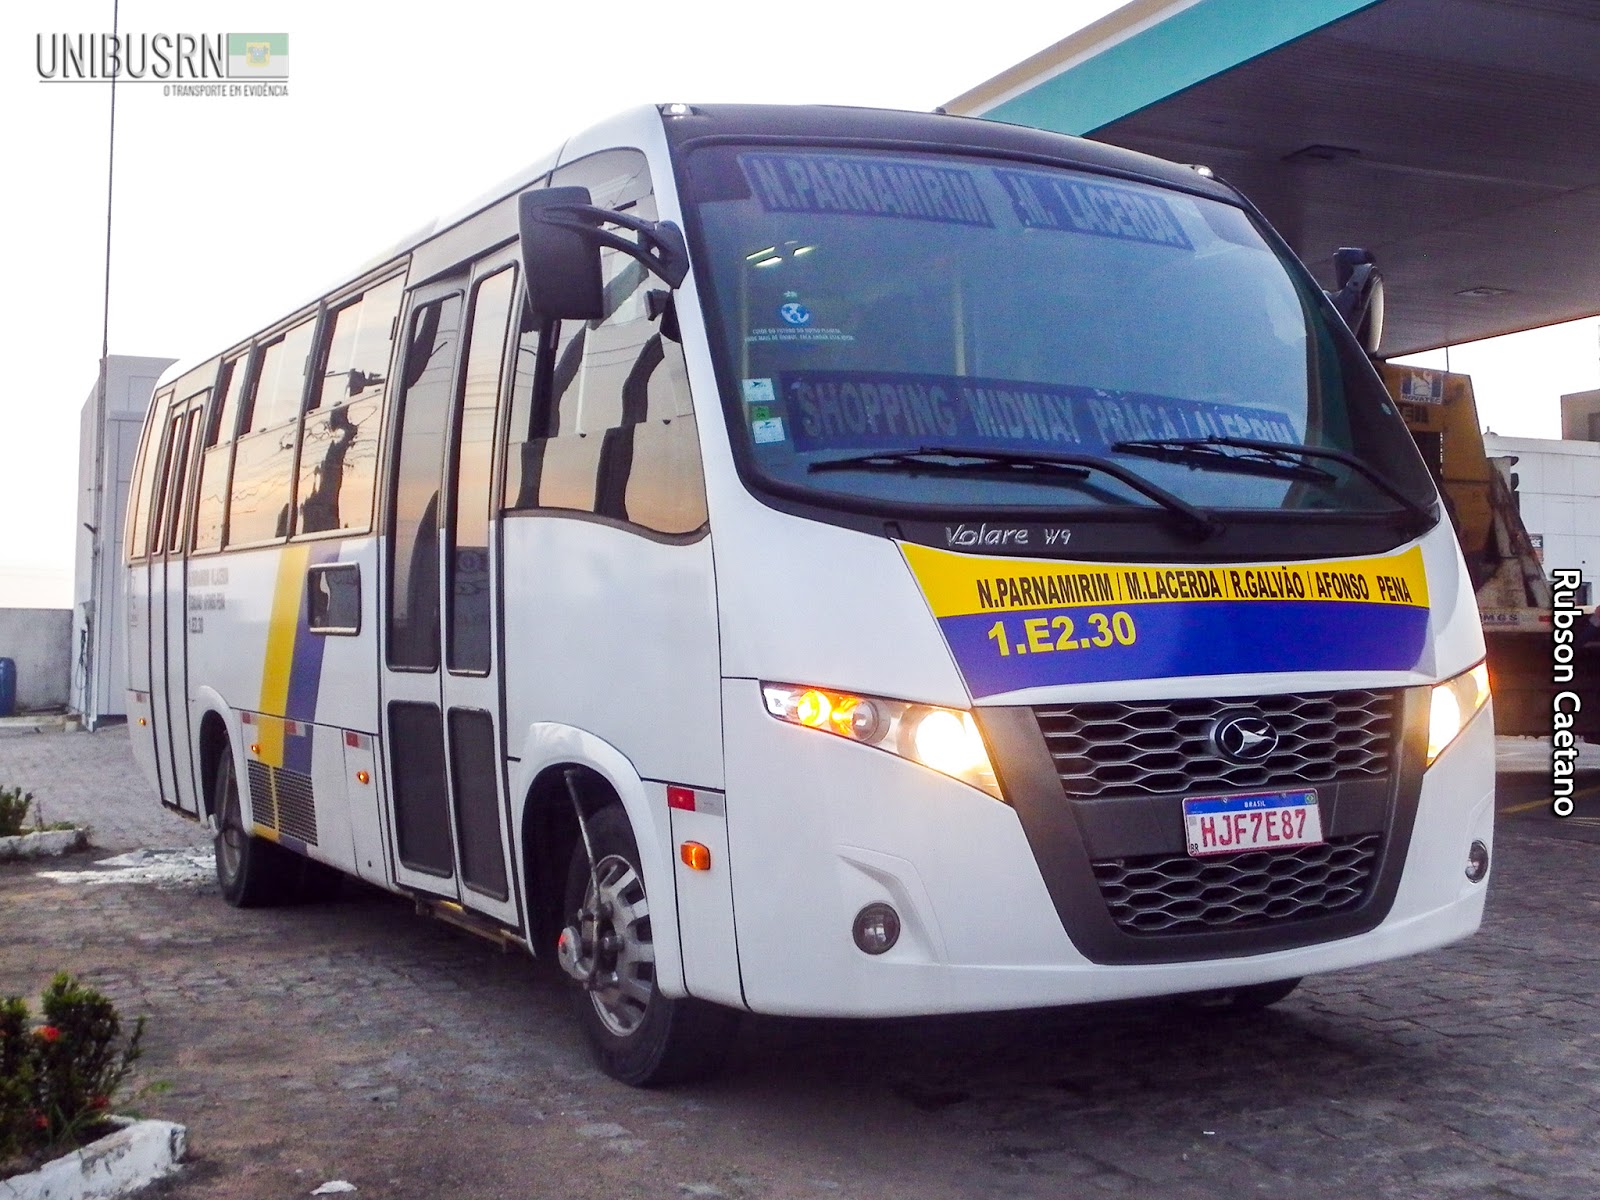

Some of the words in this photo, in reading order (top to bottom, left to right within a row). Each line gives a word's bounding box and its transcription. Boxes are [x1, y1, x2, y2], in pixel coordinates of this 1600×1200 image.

[1052, 181, 1187, 247] LACERDA
[796, 381, 959, 438] SHOPPING
[964, 387, 1081, 444] MIDWAY
[945, 522, 1029, 546] Volare
[1044, 528, 1072, 545] W9
[976, 572, 1114, 609] N.PARNAMIRIM
[1124, 570, 1223, 601] M.LACERDA
[1230, 566, 1305, 598] R.GALVÃO
[1315, 571, 1370, 601] AFONSO
[1377, 575, 1413, 603] PENA
[987, 611, 1137, 657] 1.E2.30
[1201, 808, 1307, 848] HJF7E87
